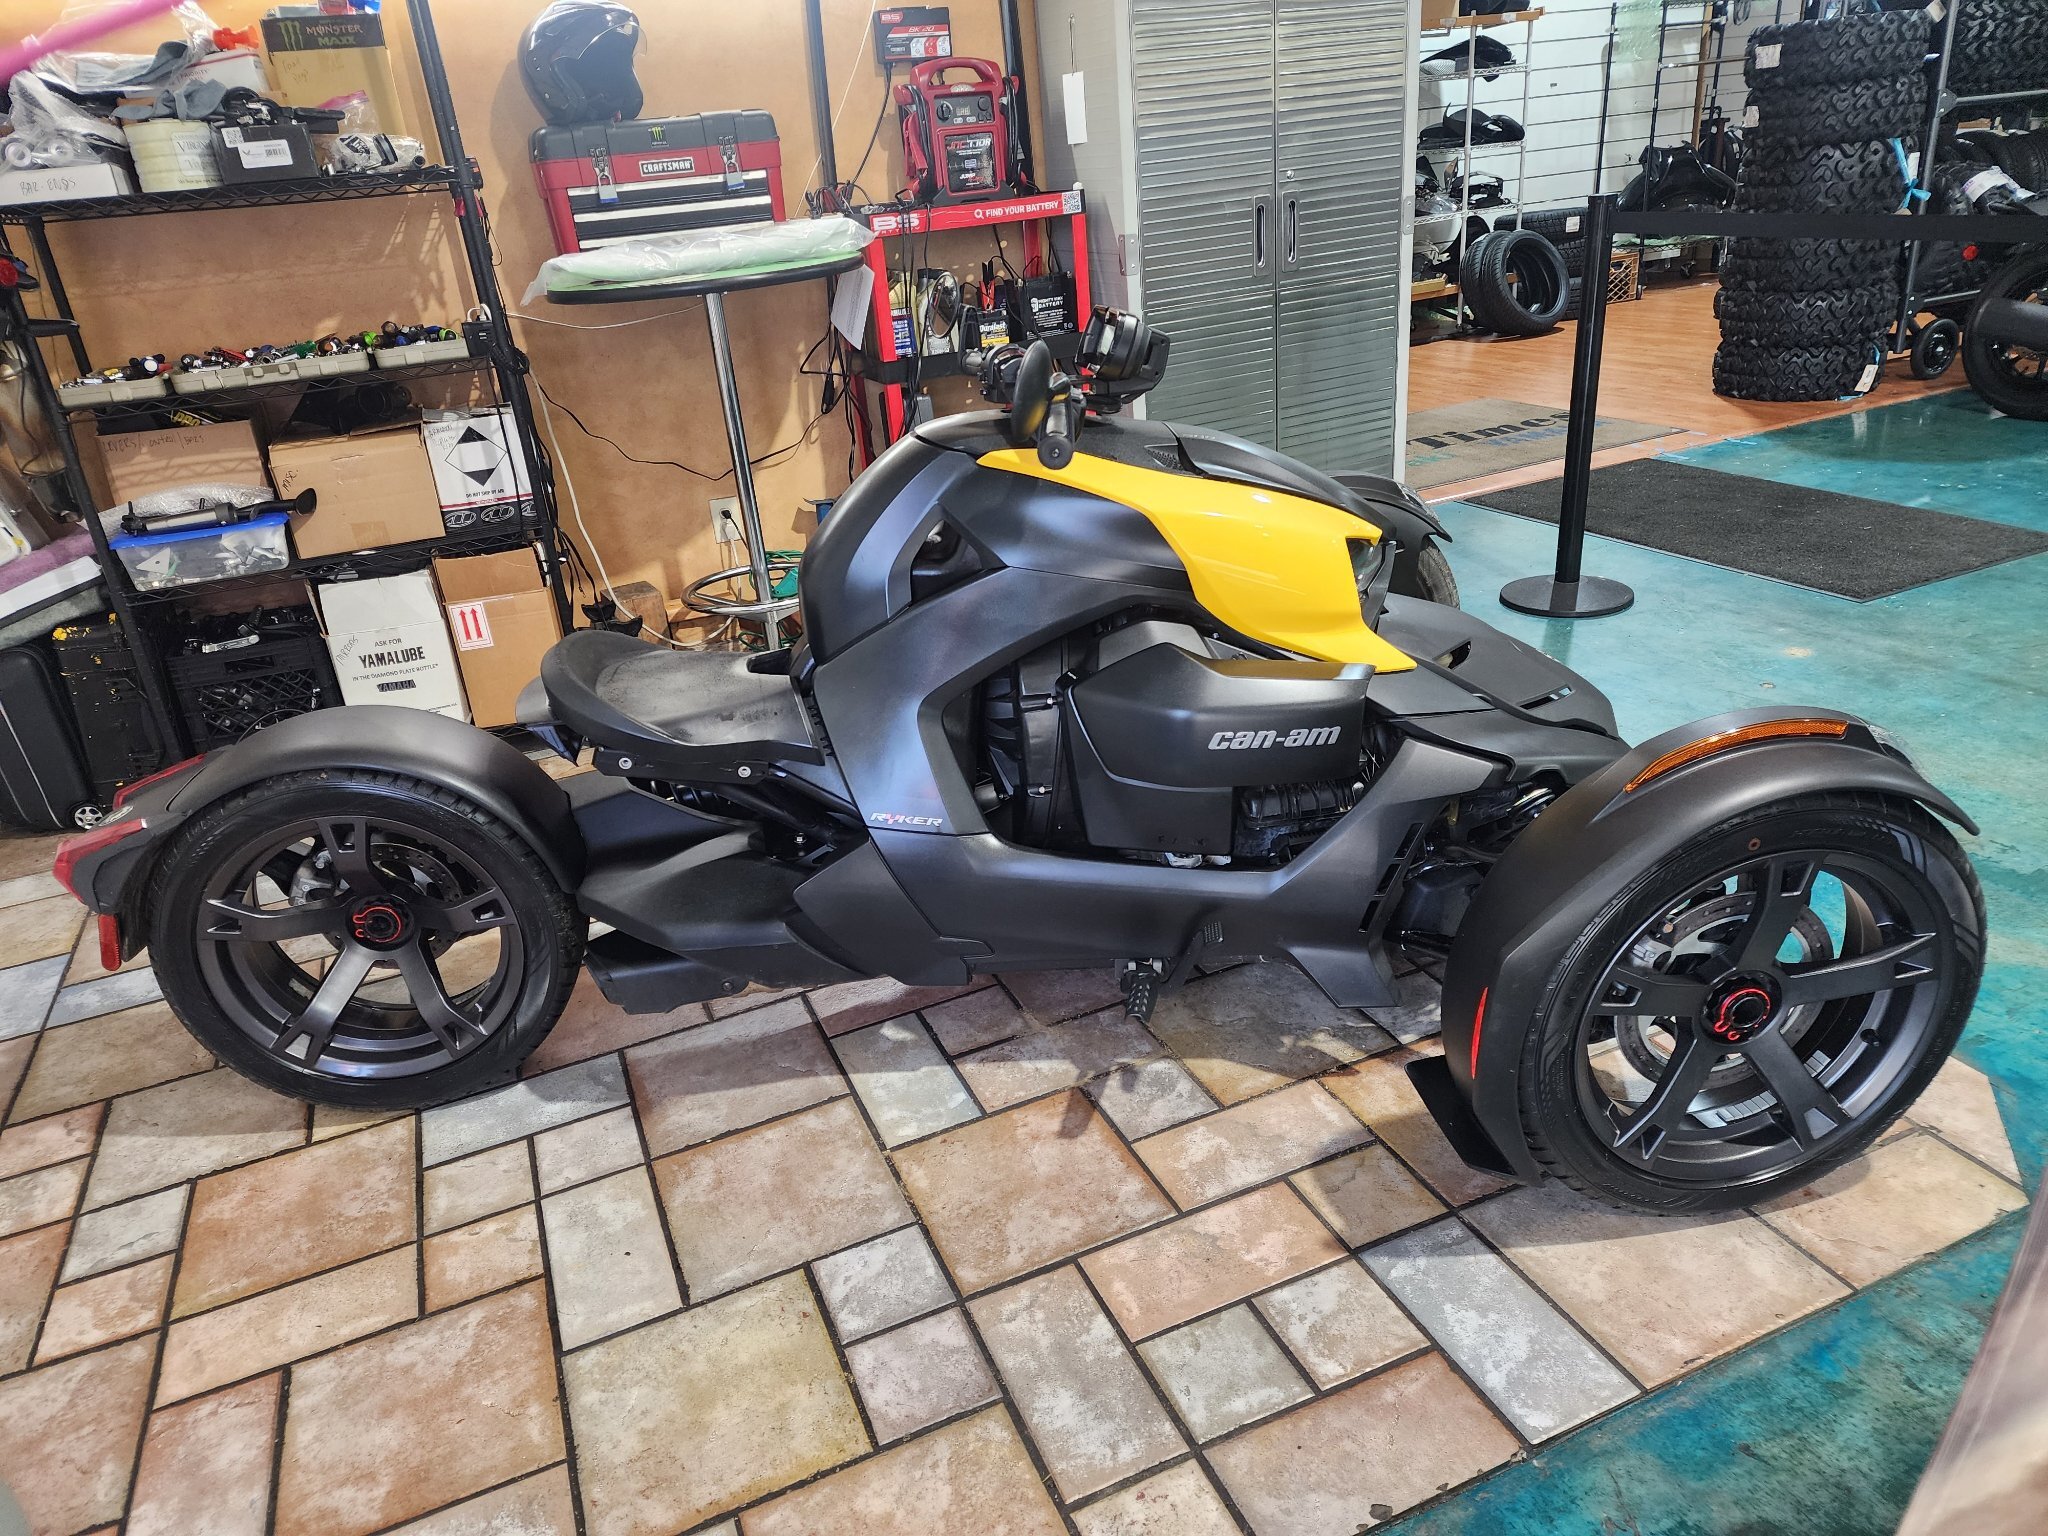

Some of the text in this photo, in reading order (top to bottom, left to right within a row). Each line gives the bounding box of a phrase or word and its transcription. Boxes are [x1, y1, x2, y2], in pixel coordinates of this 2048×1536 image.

[306, 24, 363, 36] MONSTER
[317, 36, 356, 46] MAXX
[642, 160, 691, 173] CRAFTSMAN
[985, 201, 1059, 217] FIND YOUR BATTERY
[872, 213, 920, 230] BS
[375, 640, 388, 648] ASK
[358, 646, 426, 669] YAMALUBE
[371, 670, 399, 679] DIAMOND
[400, 667, 416, 675] PLATE
[377, 679, 416, 692] YAMAHA
[1207, 725, 1342, 750] can-am
[870, 812, 943, 827] RYKER
